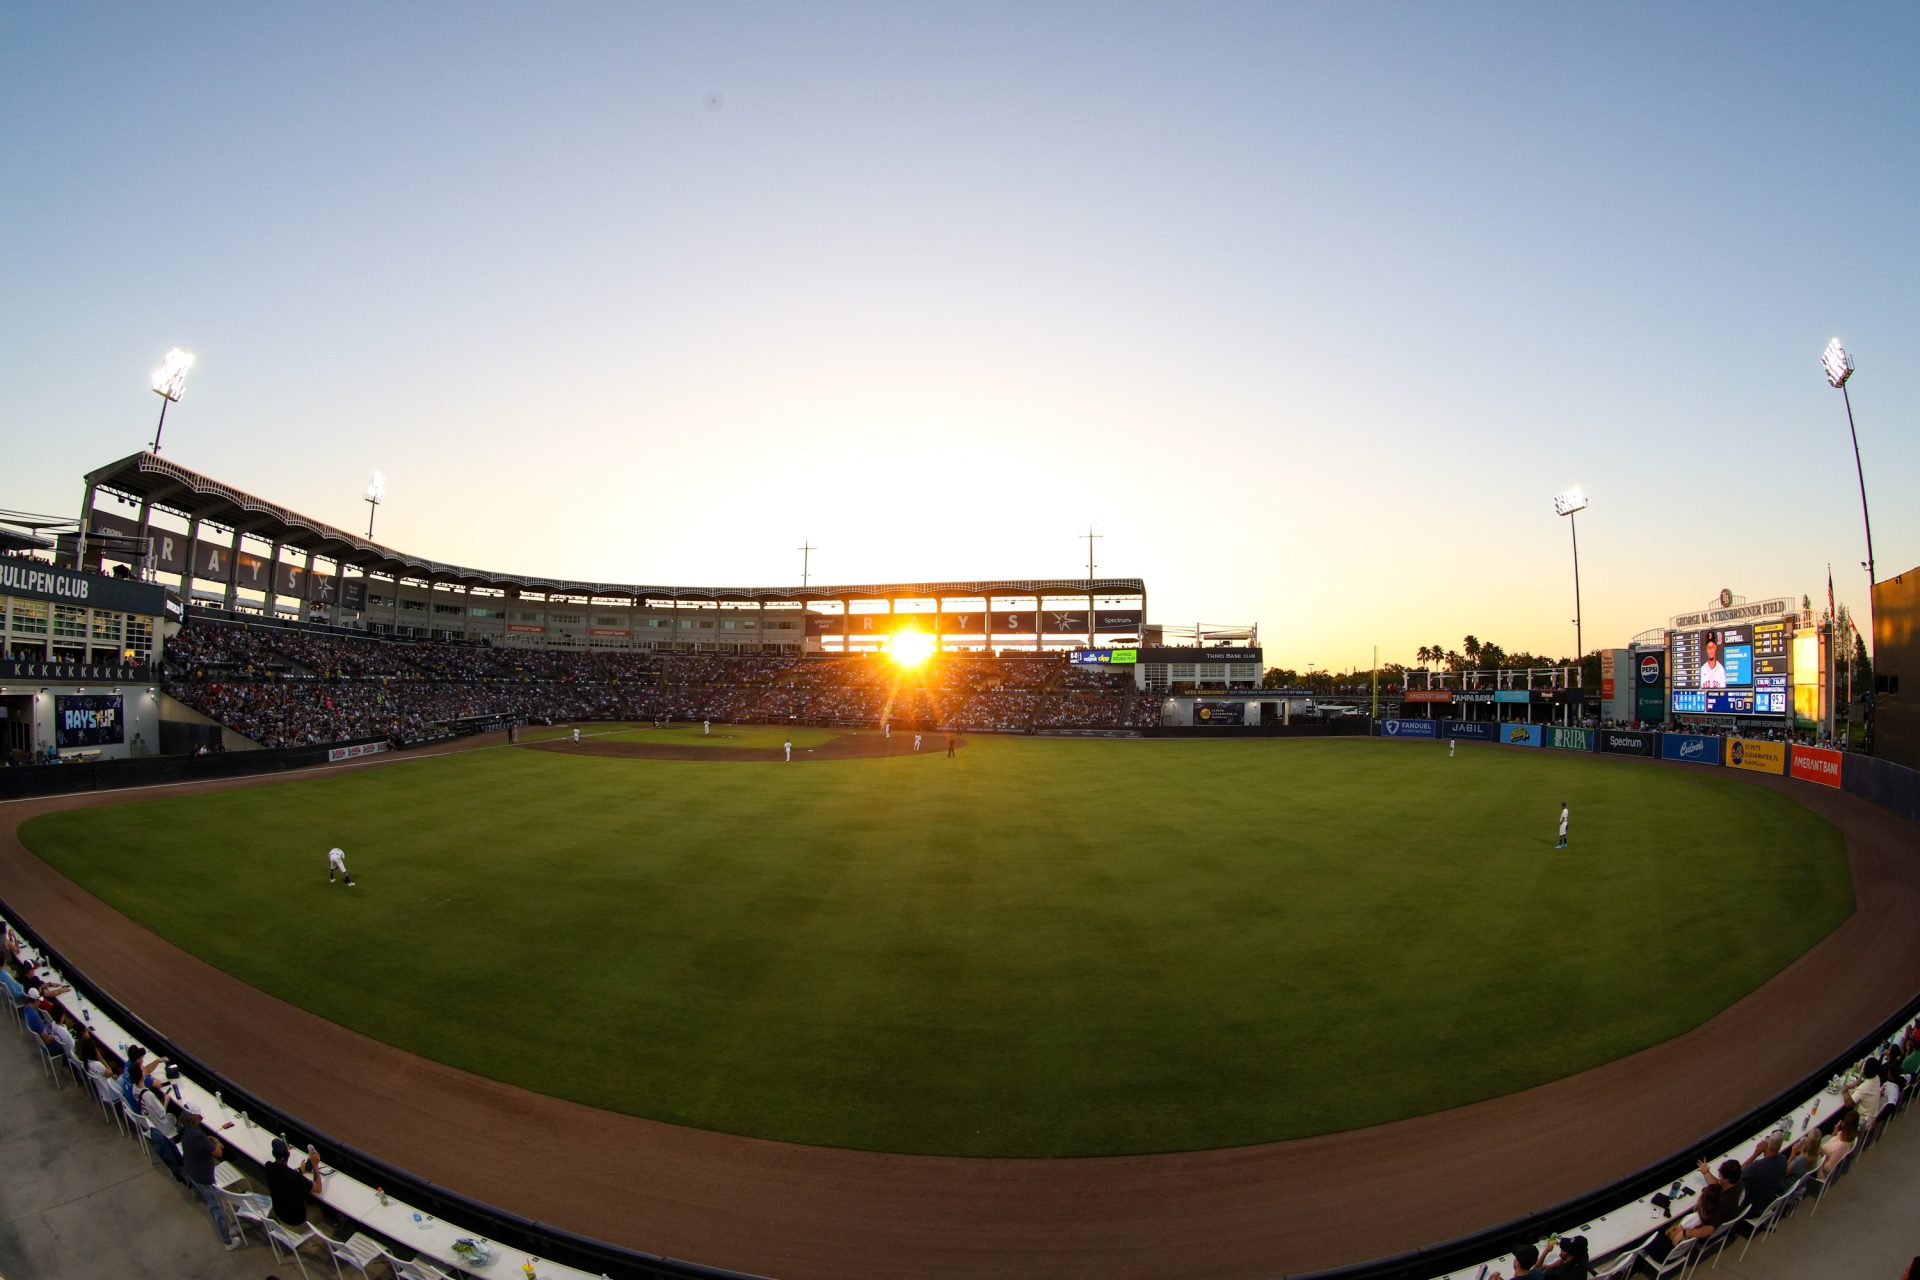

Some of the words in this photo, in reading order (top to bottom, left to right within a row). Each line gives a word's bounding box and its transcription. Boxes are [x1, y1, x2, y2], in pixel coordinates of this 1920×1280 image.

[57, 575, 89, 599] CLUB
[1676, 614, 1700, 627] GEORGE
[1701, 614, 1709, 624] M.
[1710, 605, 1762, 622] STEINBRENNER
[1763, 601, 1785, 615] FIELD
[1104, 617, 1130, 625] Spectrum
[1724, 634, 1744, 643] CAMPBELL
[1452, 694, 1474, 702] TAMPA
[1772, 694, 1784, 705] 95.2
[65, 710, 97, 730] RAYS
[100, 708, 115, 728] UP
[1401, 722, 1432, 730] FANDUEL
[1452, 723, 1484, 733] JABIL
[1563, 729, 1586, 750] RIPA
[1610, 735, 1642, 749] Spectrum
[1793, 756, 1823, 771] AMERANT
[1823, 760, 1839, 776] BANK
